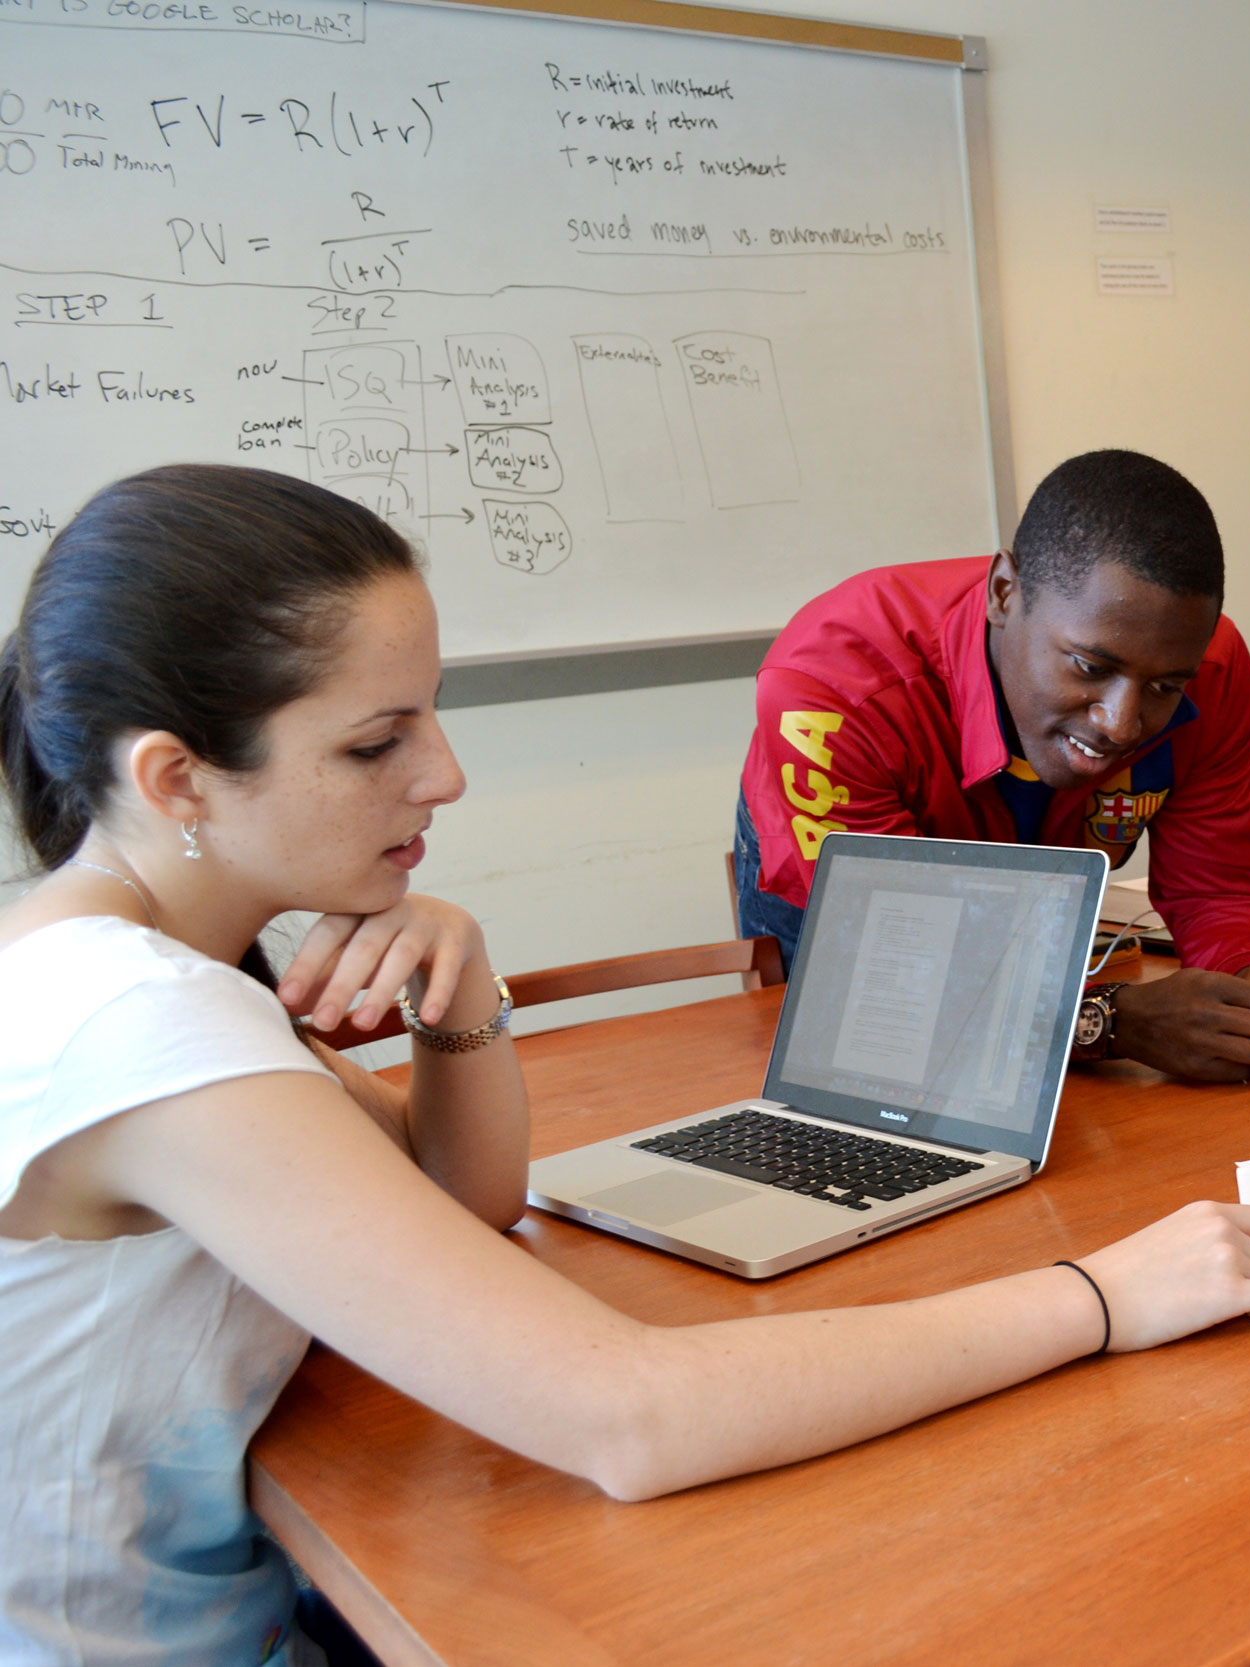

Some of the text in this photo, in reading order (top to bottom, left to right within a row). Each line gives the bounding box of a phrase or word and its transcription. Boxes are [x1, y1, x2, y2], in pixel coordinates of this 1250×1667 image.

[106, 0, 219, 21] GOOGLE
[232, 5, 351, 38] SCHOLAR?
[150, 94, 224, 148] FV
[595, 111, 635, 131] rate
[645, 110, 659, 134] of
[668, 111, 719, 130] return
[57, 144, 104, 168] Total
[604, 153, 654, 186] years
[663, 151, 685, 175] of
[699, 154, 787, 178] investment
[166, 217, 226, 275] PV
[567, 214, 633, 242] saved
[651, 223, 712, 254] money
[15, 292, 165, 321] STEP 1
[306, 294, 398, 330] Step 2
[682, 343, 736, 364] Cost
[98, 371, 196, 403] Failures
[237, 433, 282, 451] ban
